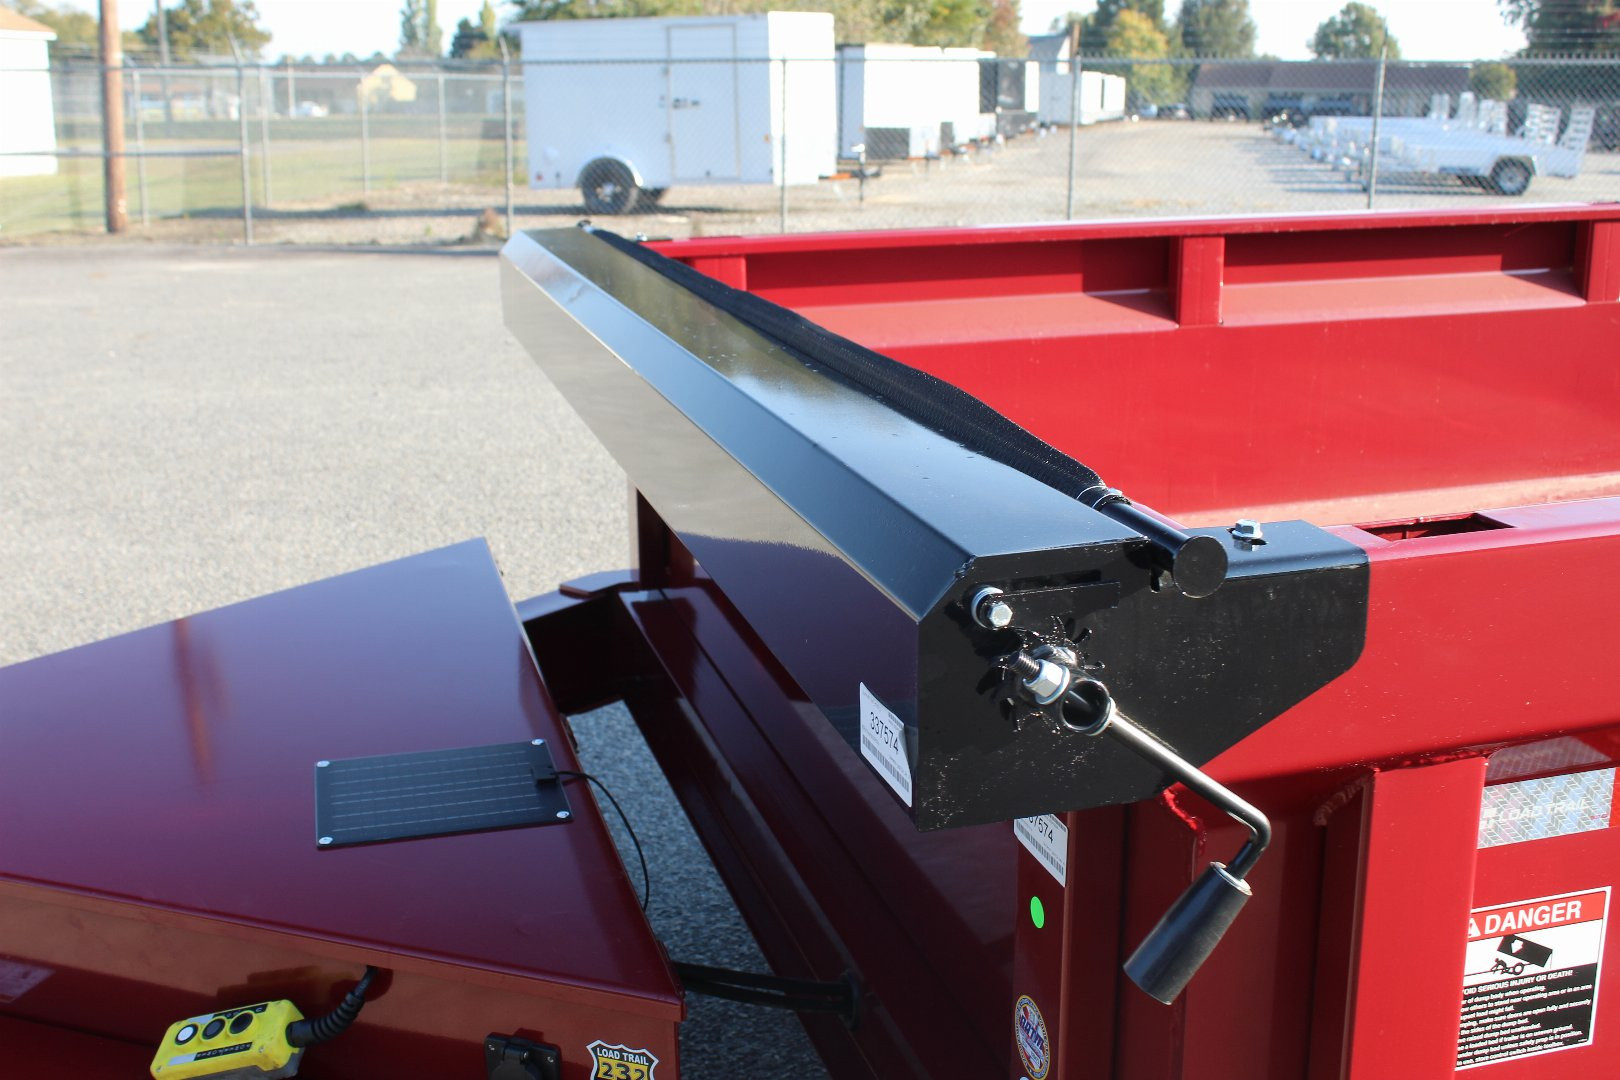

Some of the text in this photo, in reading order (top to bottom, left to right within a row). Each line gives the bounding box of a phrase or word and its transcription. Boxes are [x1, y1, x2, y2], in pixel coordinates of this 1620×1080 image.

[870, 711, 899, 755] 337574
[1484, 900, 1582, 935] DANGER
[1478, 982, 1509, 993] SERIOUS
[1510, 976, 1535, 987] INJURY
[1536, 974, 1547, 982] OR
[1547, 970, 1573, 980] DEATH!
[596, 1047, 649, 1065] LOAD TRAIL
